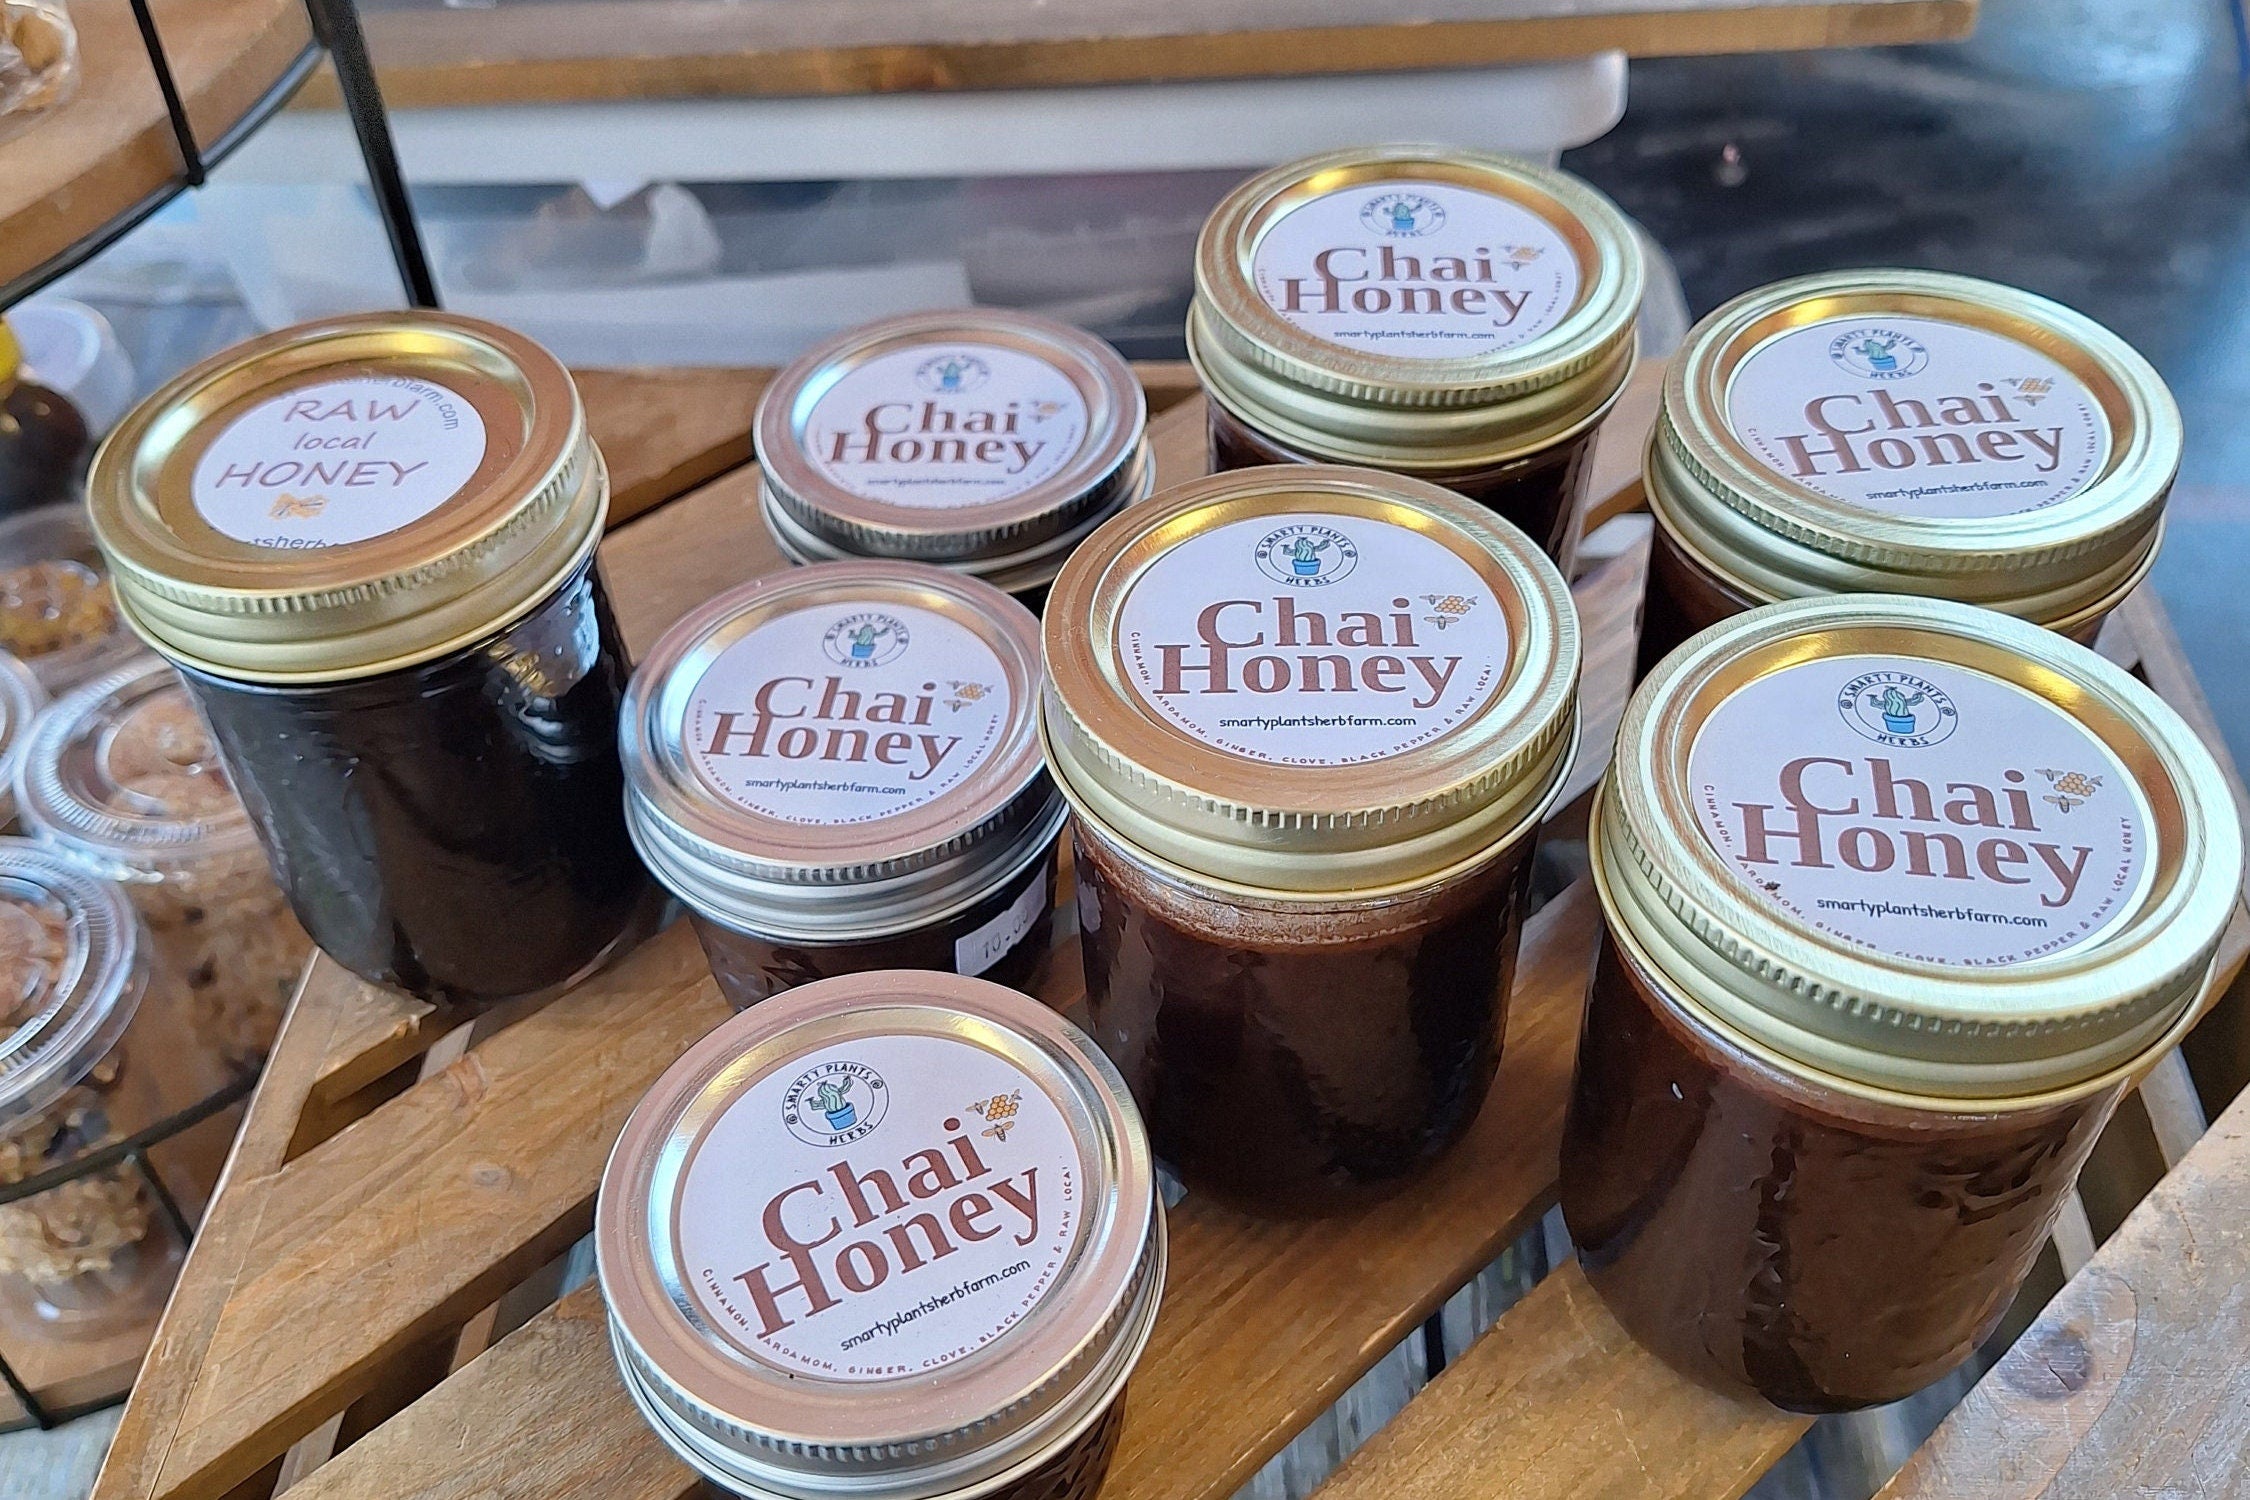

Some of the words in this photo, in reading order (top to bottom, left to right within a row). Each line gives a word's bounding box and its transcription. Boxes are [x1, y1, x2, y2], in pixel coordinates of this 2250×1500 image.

[1313, 246, 1496, 283] Chai
[1278, 277, 1532, 327] Honey
[1333, 330, 1496, 341] smartyplantsherbfarm.com
[284, 399, 421, 423] RAW
[865, 401, 1020, 434] Chai
[1804, 382, 2020, 435] Chai
[292, 431, 378, 451] local
[825, 431, 1046, 474] Honey
[1774, 427, 2063, 477] Honey
[215, 460, 429, 489] HONEY
[1865, 480, 2049, 501] smartyplantsherbfarm.com
[1262, 526, 1304, 548] SMARTY
[1311, 527, 1352, 548] PLANTS
[1196, 597, 1420, 648] Chai
[1153, 643, 1463, 709] Honey
[1844, 673, 1891, 697] SMARTY
[1900, 675, 1947, 704] PLANTS
[754, 676, 937, 727] Chai
[1155, 695, 1208, 738] ARDAMOM,
[1341, 750, 1387, 763] BLACK
[1393, 727, 1441, 751] PEPPER
[1455, 695, 1475, 715] RAW
[1219, 715, 1417, 731] smartyplantsherbfarm.com
[1877, 733, 1929, 746] HERBS
[700, 711, 962, 781] Honey
[745, 778, 906, 796] smartyplantsherbfarm.com
[1779, 757, 2041, 832] Chai
[2119, 816, 2132, 853] HONEY
[1731, 802, 2093, 907] Honey
[2112, 859, 2131, 892] LOCAL
[1816, 898, 2048, 929] smartyplantsherbfarm.com
[2092, 897, 2114, 919] RAW
[2024, 931, 2078, 959] PEPPER
[786, 1070, 819, 1110] SMARTY
[826, 1063, 872, 1080] PLANTS
[829, 1122, 873, 1145] HERBS
[762, 1117, 993, 1249] Chai
[733, 1166, 1038, 1339] Honey
[763, 1337, 837, 1372] ARDAMOM,
[979, 1311, 1019, 1343] BLACK
[1022, 1261, 1056, 1308] PEPPER
[1053, 1245, 1063, 1254] &
[1059, 1210, 1072, 1237] RAW
[840, 1259, 1031, 1351] smartyplantsherbfarm.com
